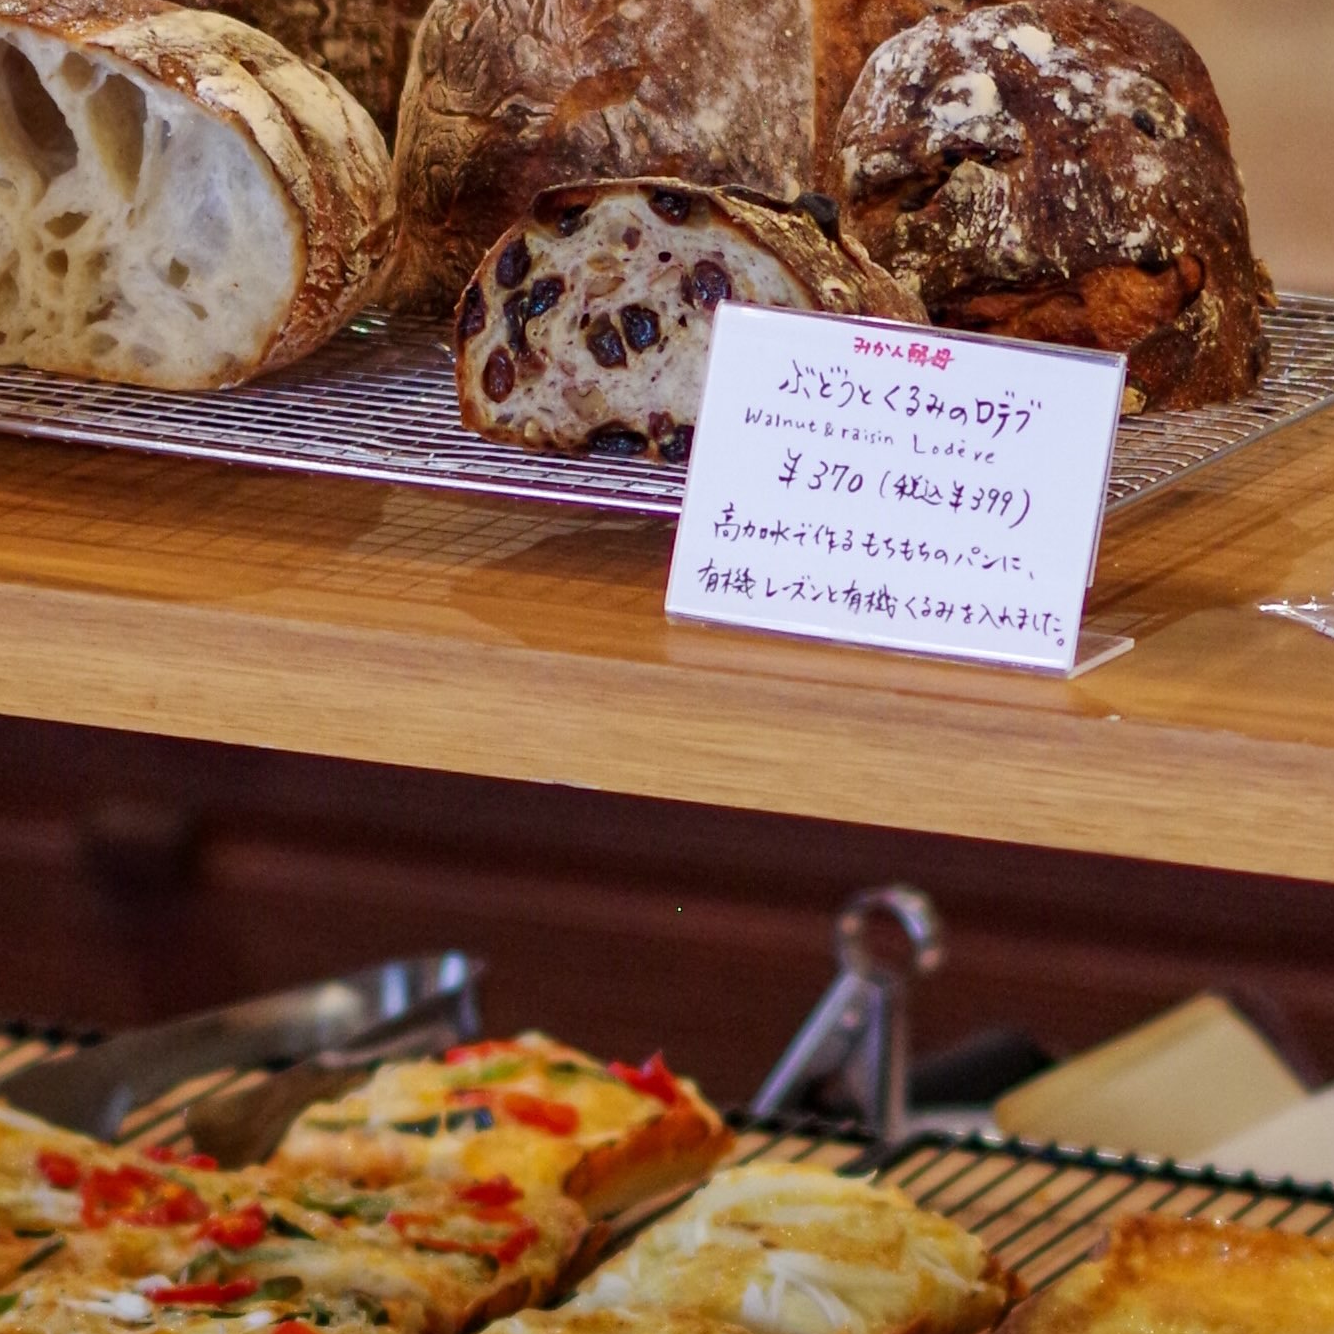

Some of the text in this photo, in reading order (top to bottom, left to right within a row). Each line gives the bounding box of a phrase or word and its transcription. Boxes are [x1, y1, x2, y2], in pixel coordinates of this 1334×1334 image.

[853, 336, 956, 371] みかん酵母
[778, 360, 1042, 438] ぶどうとくるみのロデブ
[745, 407, 819, 434] Walnut
[842, 425, 895, 446] raisin
[913, 434, 995, 464] Lodève
